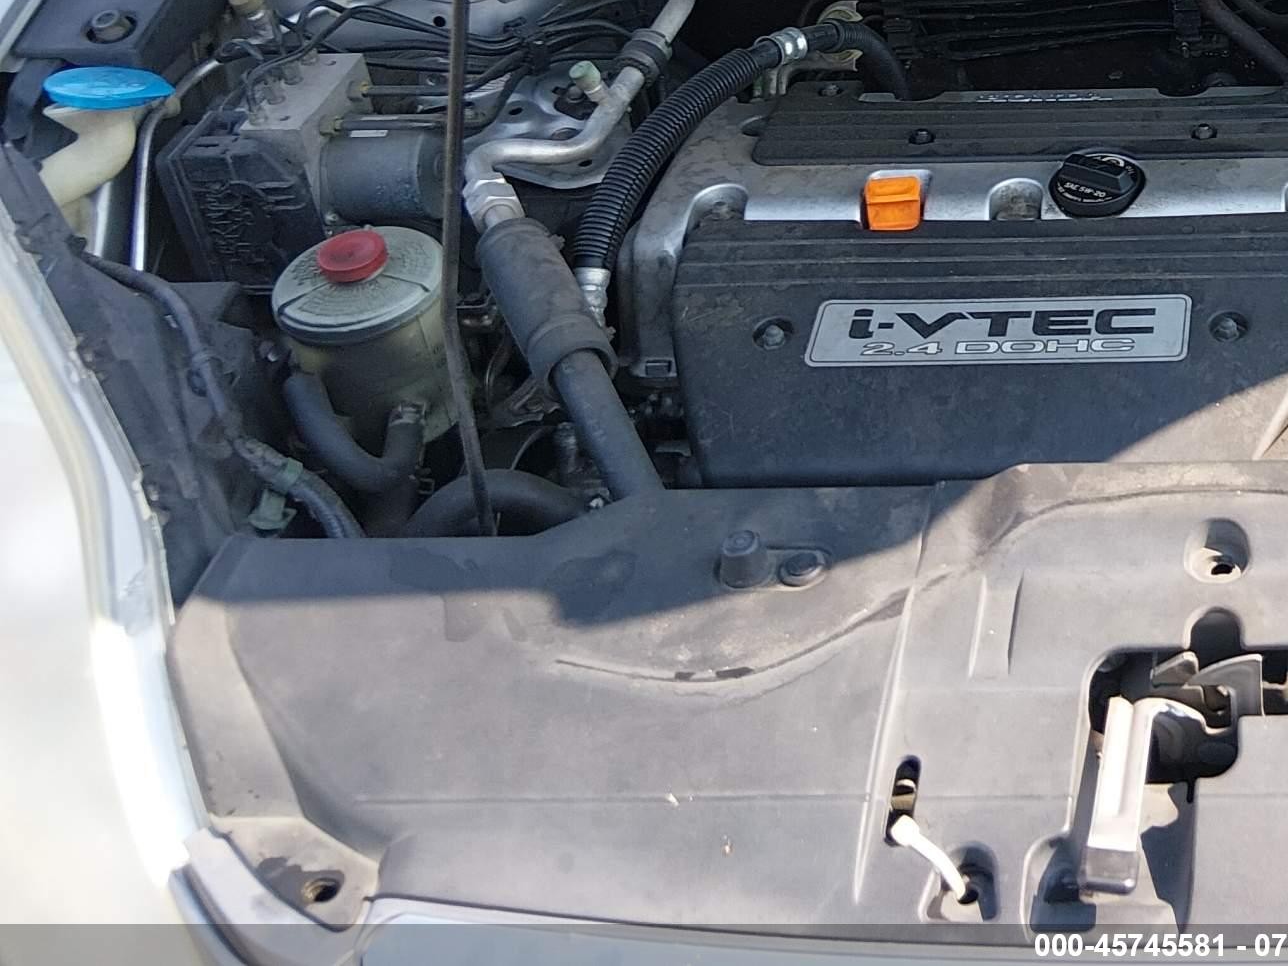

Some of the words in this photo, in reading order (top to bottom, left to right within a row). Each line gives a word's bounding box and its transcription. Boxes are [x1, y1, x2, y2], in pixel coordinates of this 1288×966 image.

[1063, 181, 1080, 191] SAE
[1078, 185, 1107, 198] 5W-20
[848, 307, 1157, 340] i-VTEC
[859, 341, 943, 356] 2.4
[954, 337, 1136, 355] DOHC
